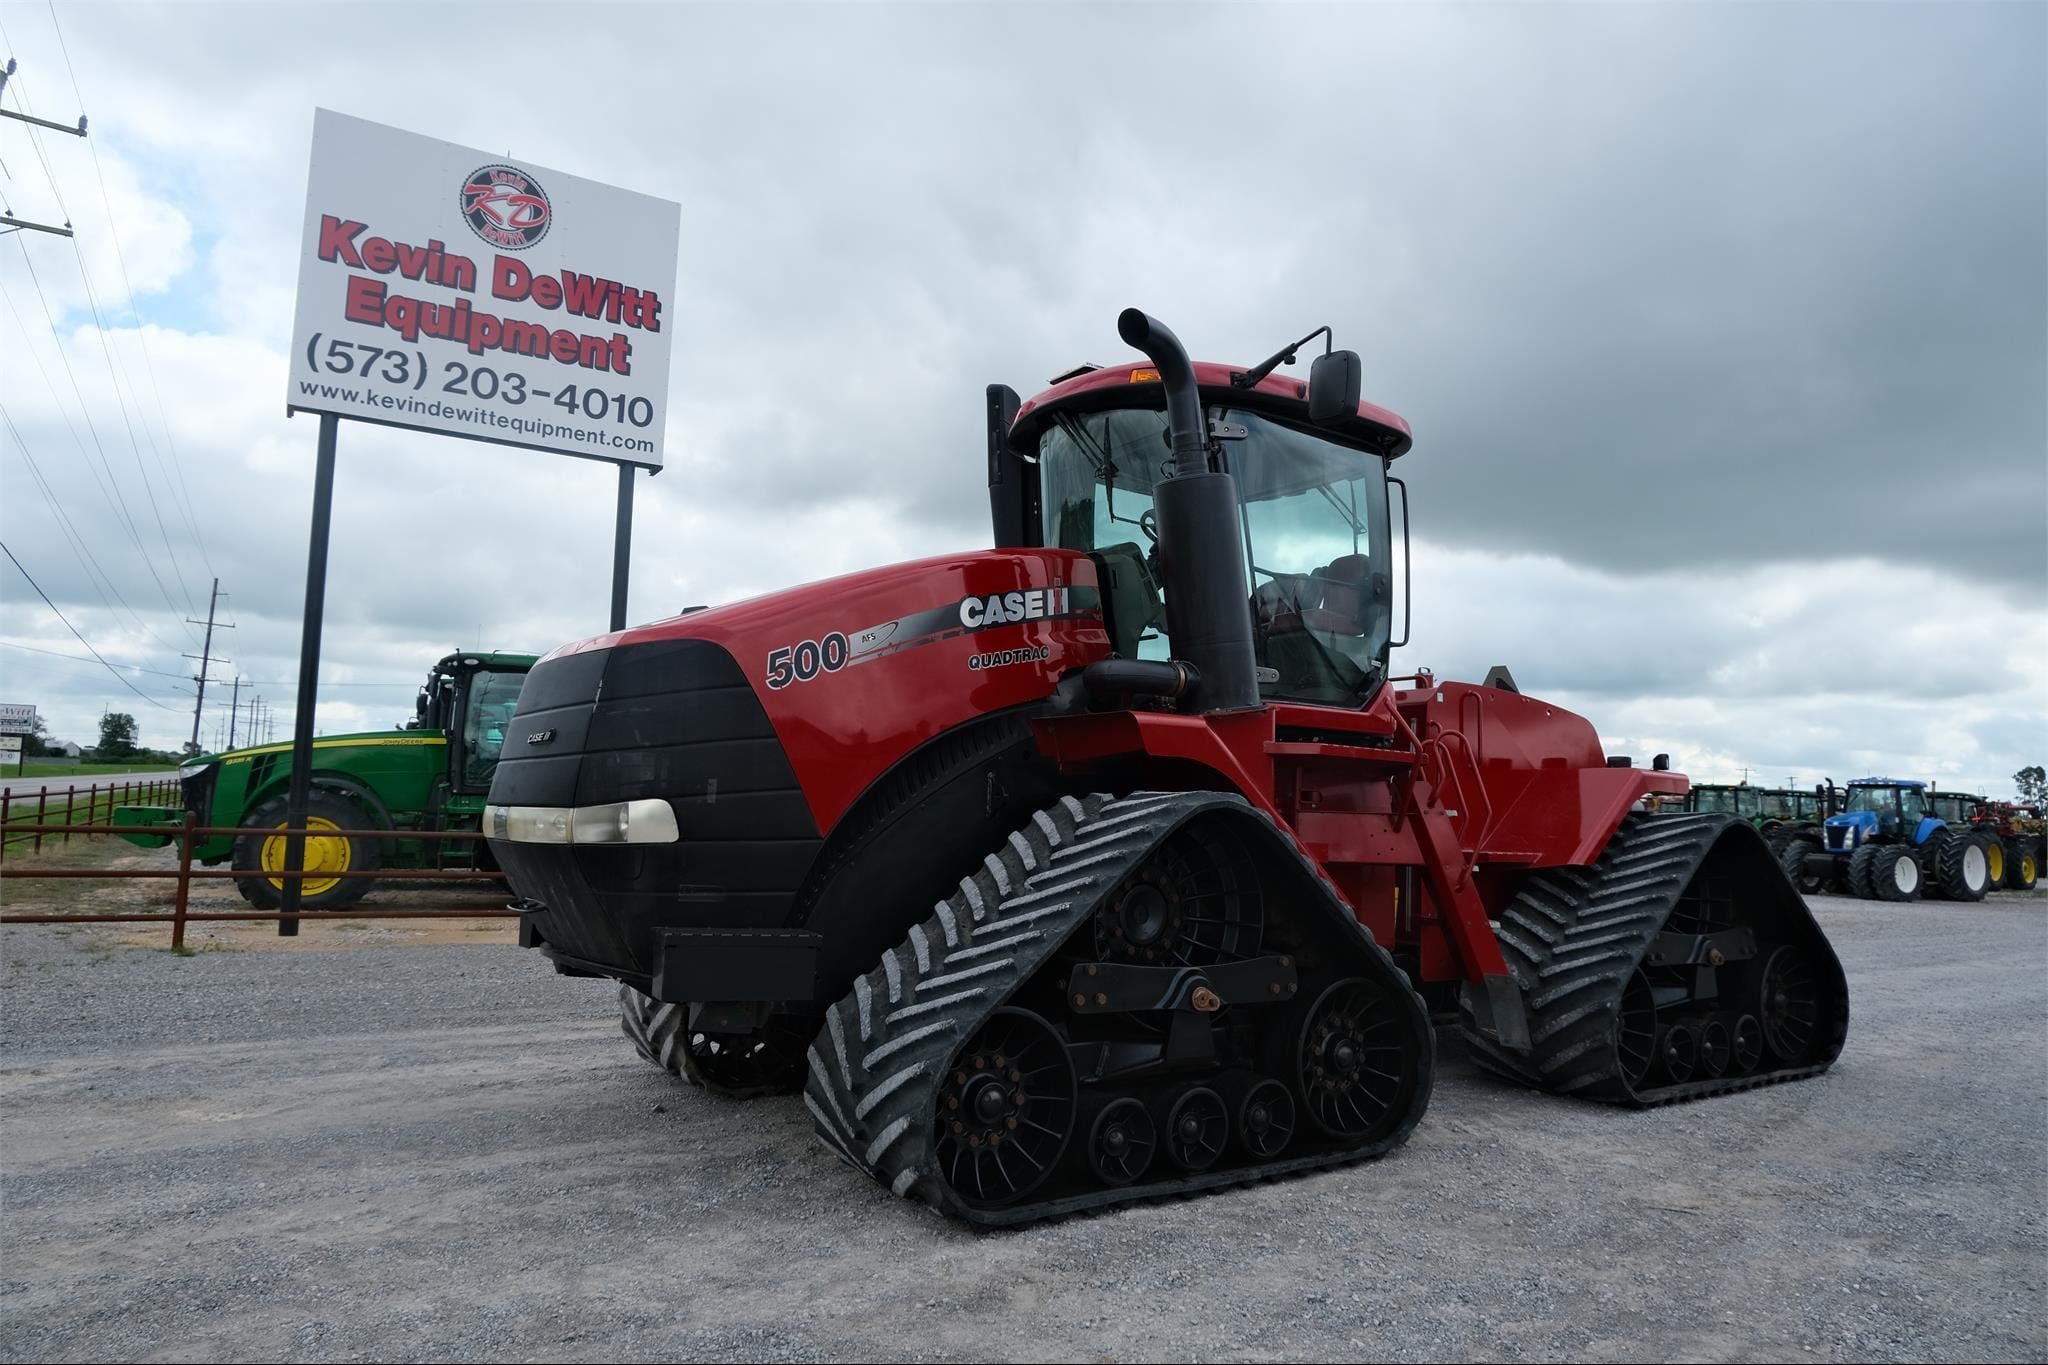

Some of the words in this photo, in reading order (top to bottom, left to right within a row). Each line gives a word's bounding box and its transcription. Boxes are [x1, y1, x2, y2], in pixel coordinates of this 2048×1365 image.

[489, 169, 528, 191] Kevin
[317, 214, 477, 292] Kevin
[491, 254, 662, 333] DeWitt
[344, 274, 632, 376] Equipment
[306, 332, 428, 390] (573)
[442, 361, 654, 428] 203-4010
[299, 380, 655, 453] www.kevindewittequipment.com
[861, 632, 877, 643] AFS
[960, 590, 1044, 628] CASE
[765, 631, 849, 690] 500
[968, 645, 1050, 671] QUADTRAC
